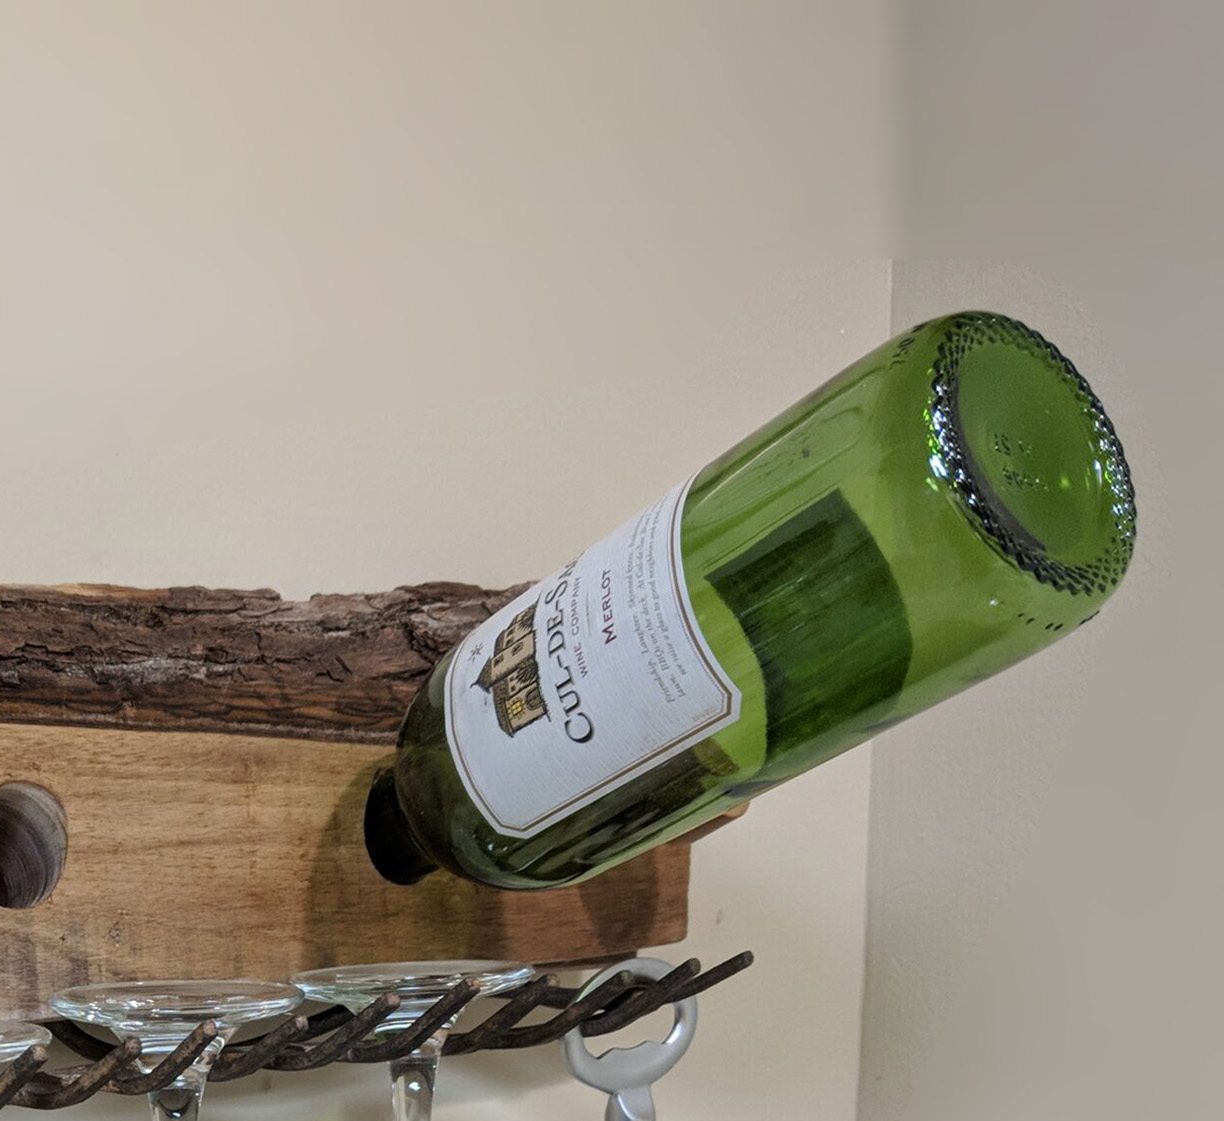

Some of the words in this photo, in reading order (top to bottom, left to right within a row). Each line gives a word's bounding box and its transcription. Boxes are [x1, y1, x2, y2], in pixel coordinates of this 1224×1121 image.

[571, 576, 582, 636] COMPANY
[601, 569, 617, 645] MERLOT
[643, 618, 654, 632] the
[656, 612, 669, 633] glass
[649, 632, 658, 645] on
[573, 642, 588, 679] WINE
[677, 663, 687, 676] we
